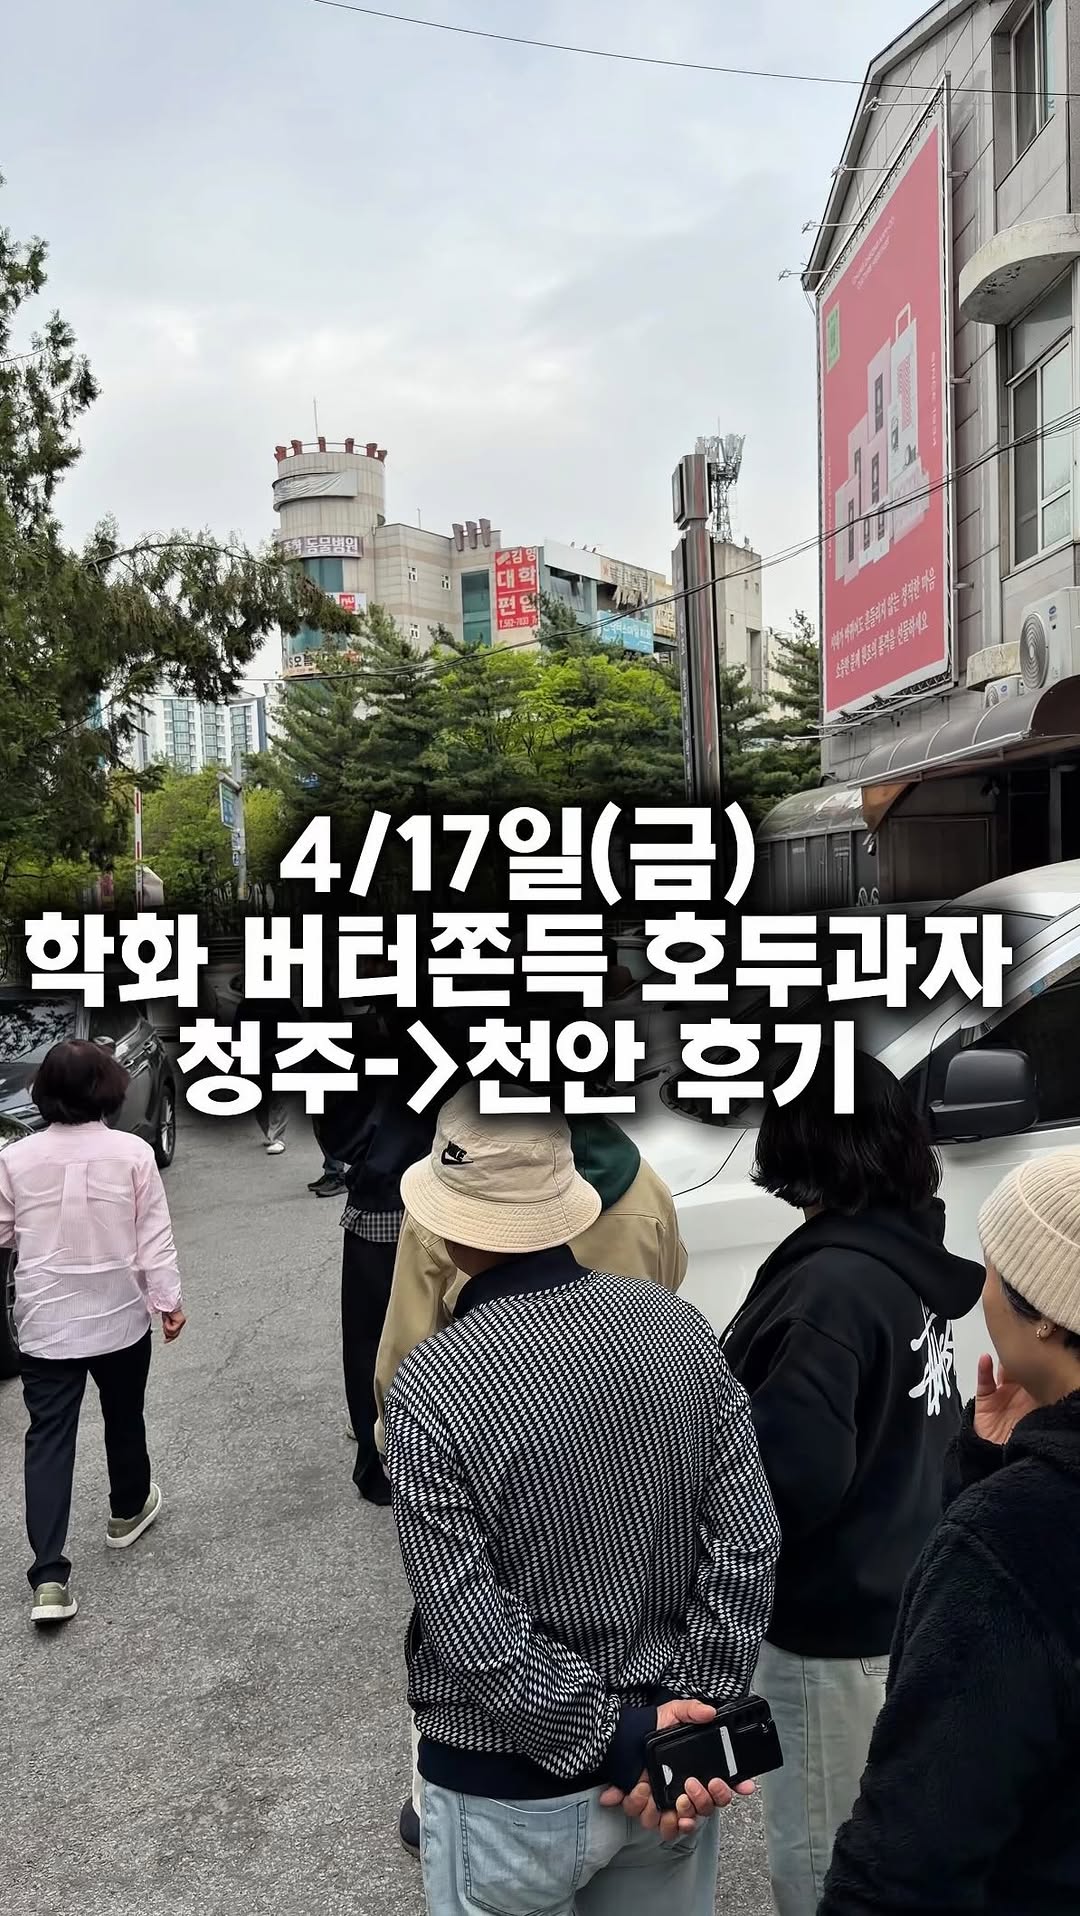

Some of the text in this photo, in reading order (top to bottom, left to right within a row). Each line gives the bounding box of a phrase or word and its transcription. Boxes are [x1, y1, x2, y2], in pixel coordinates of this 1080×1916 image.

[307, 537, 358, 554] 동물병원
[497, 566, 536, 588] 대학
[901, 575, 921, 607] 정직한
[921, 567, 936, 592] 마음
[897, 609, 929, 646] 선물하세요
